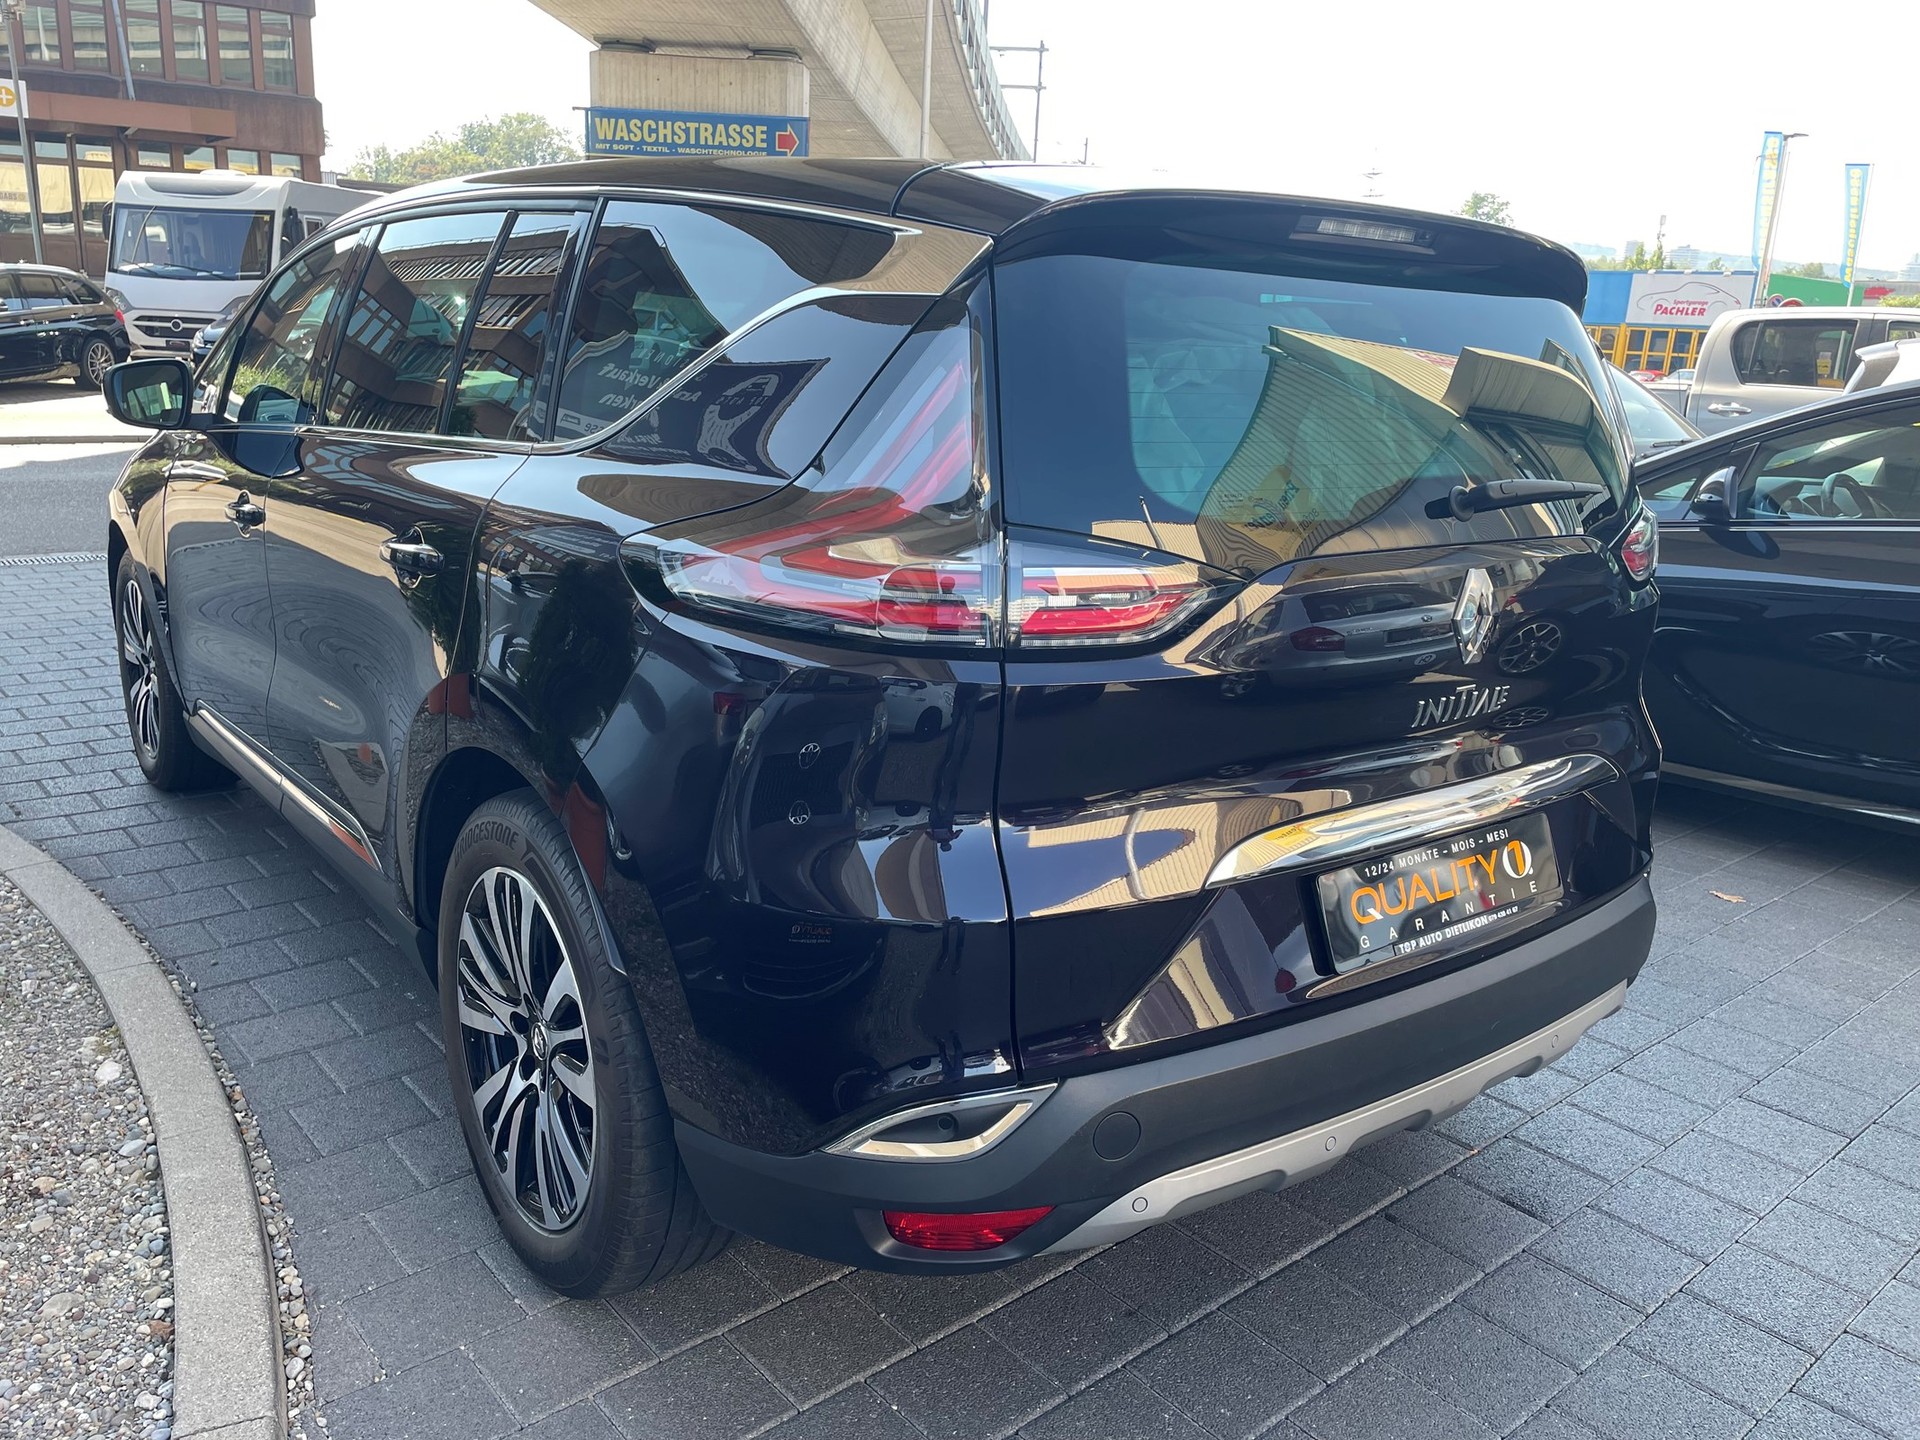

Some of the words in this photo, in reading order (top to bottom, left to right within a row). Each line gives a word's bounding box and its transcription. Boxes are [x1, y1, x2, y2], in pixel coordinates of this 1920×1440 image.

[594, 117, 768, 148] WASCHSTRASSE
[642, 145, 670, 153] TEXTIL
[677, 147, 768, 157] WASCHTECHNOLOGIE
[1653, 304, 1706, 317] PACHLER
[454, 820, 520, 869] BRIDGESTONE
[1364, 860, 1394, 878] 12/24
[1398, 848, 1440, 868] MONATE
[1451, 838, 1476, 854] MOIS
[1486, 828, 1509, 844] MESI
[1350, 849, 1499, 925] QUALITY
[1360, 880, 1538, 949] GARANTIE
[1398, 940, 1418, 954] TOP
[1419, 930, 1443, 950] AUTO
[1445, 915, 1489, 939] DIETLIKON
